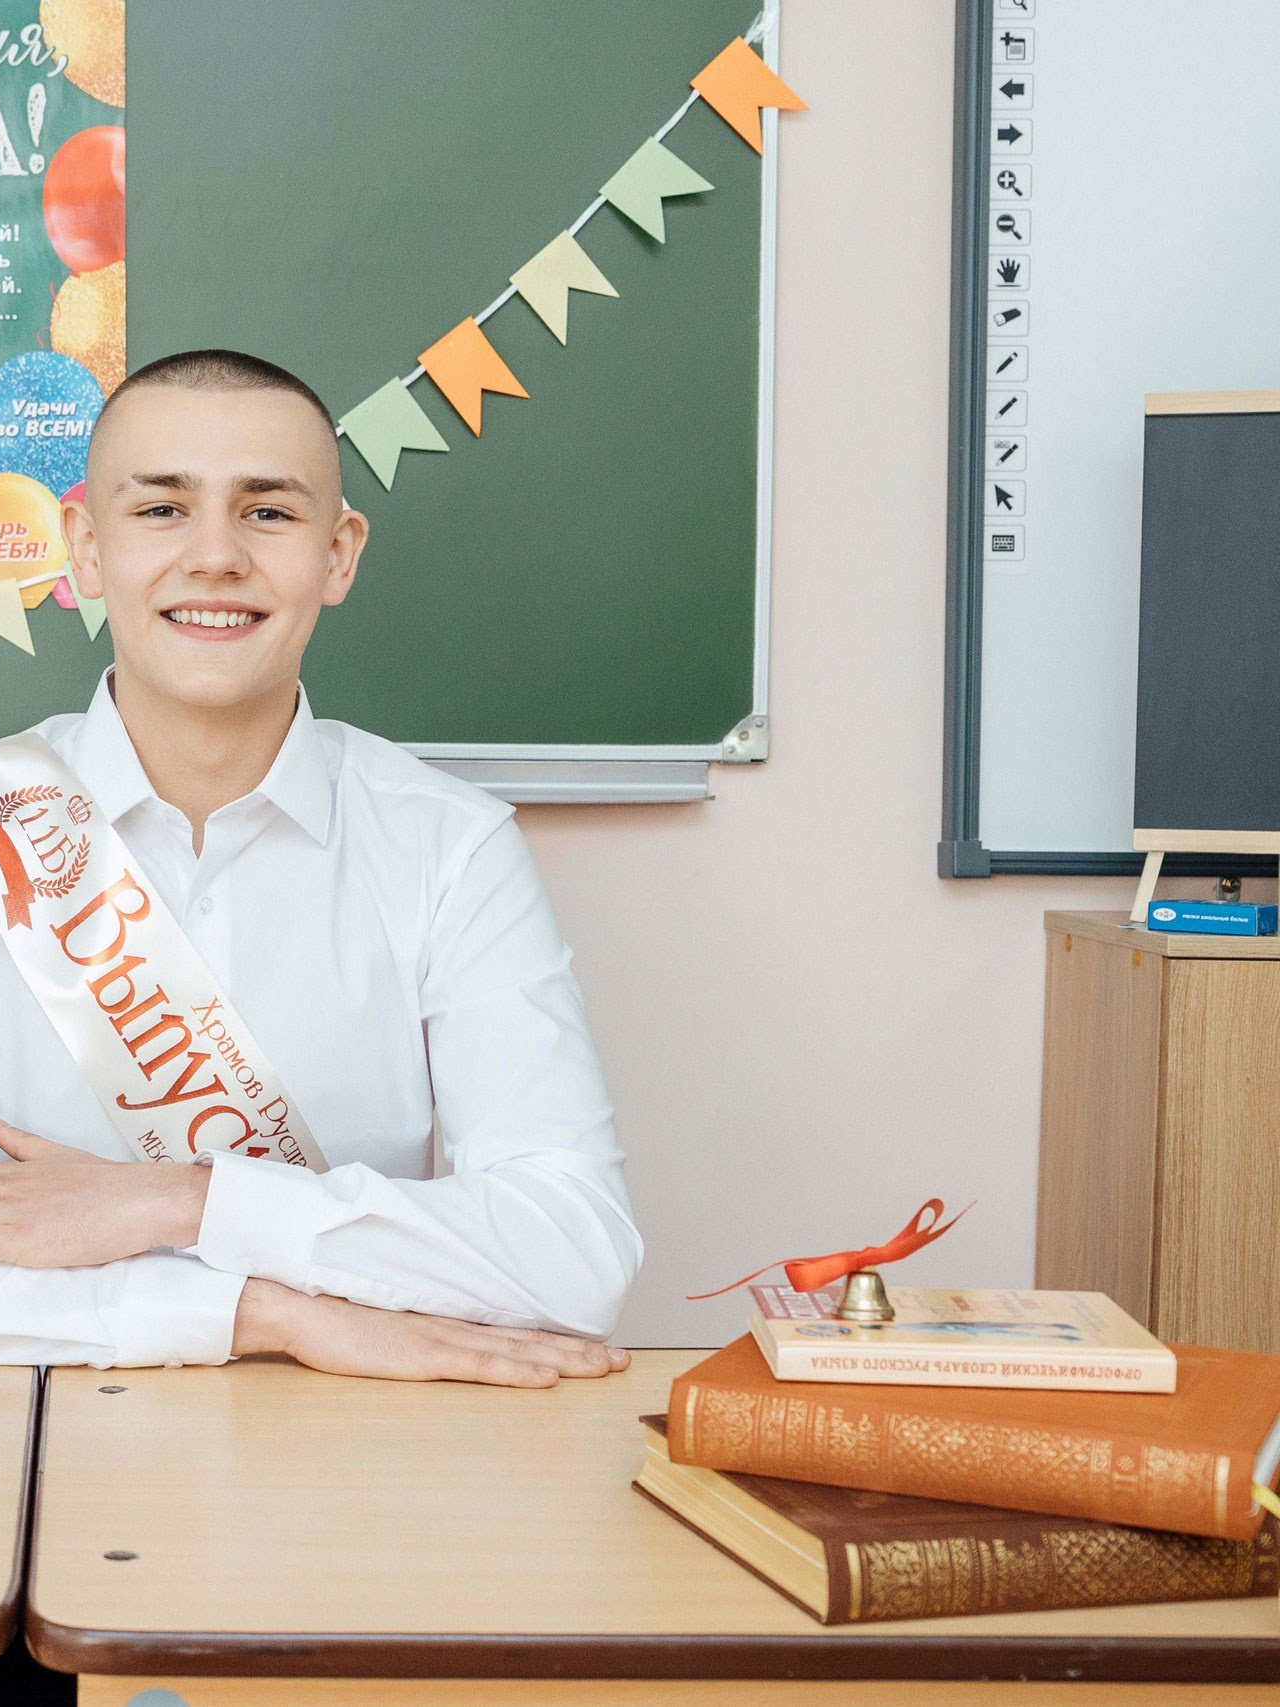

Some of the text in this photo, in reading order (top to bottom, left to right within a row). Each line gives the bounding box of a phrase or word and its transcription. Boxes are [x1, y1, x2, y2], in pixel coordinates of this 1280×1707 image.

[12, 398, 77, 418] Удачи
[24, 419, 93, 438] ВСЕМ!
[14, 807, 78, 874] 11Б
[50, 867, 270, 1157] Выпус
[191, 994, 264, 1100] Храмов
[810, 1356, 1143, 1381] ОРФОГРАФИЧЕСКИЙ СЛОВАРЬ РУССКОГО ЯЗЫКА
